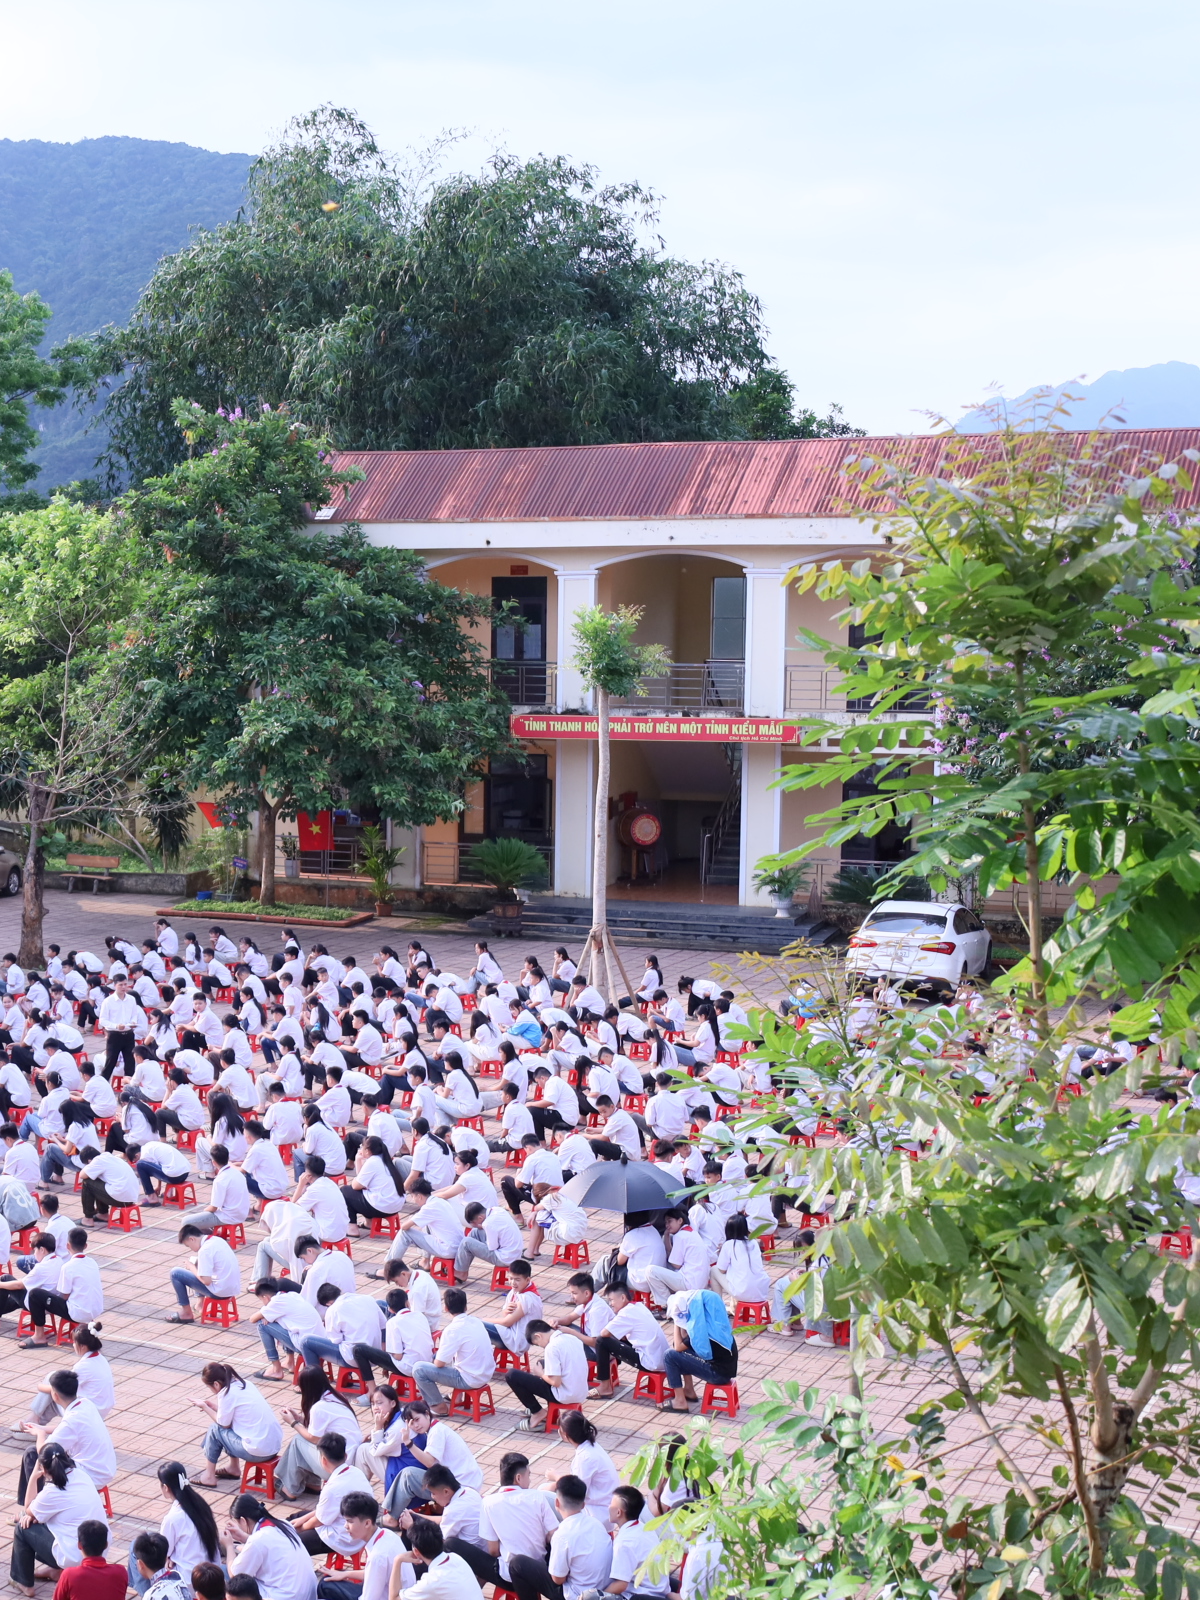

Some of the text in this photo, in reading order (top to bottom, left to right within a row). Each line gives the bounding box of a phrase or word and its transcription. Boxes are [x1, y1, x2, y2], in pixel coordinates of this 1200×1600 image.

[549, 721, 582, 732] THANH
[584, 720, 599, 732] HÓ
[608, 718, 631, 733] PHẢI
[634, 718, 653, 733] TRỞ
[656, 721, 677, 734] NÊN
[680, 721, 702, 736] MỘT
[705, 720, 729, 735] TỈNH
[731, 720, 756, 735] KIỂU
